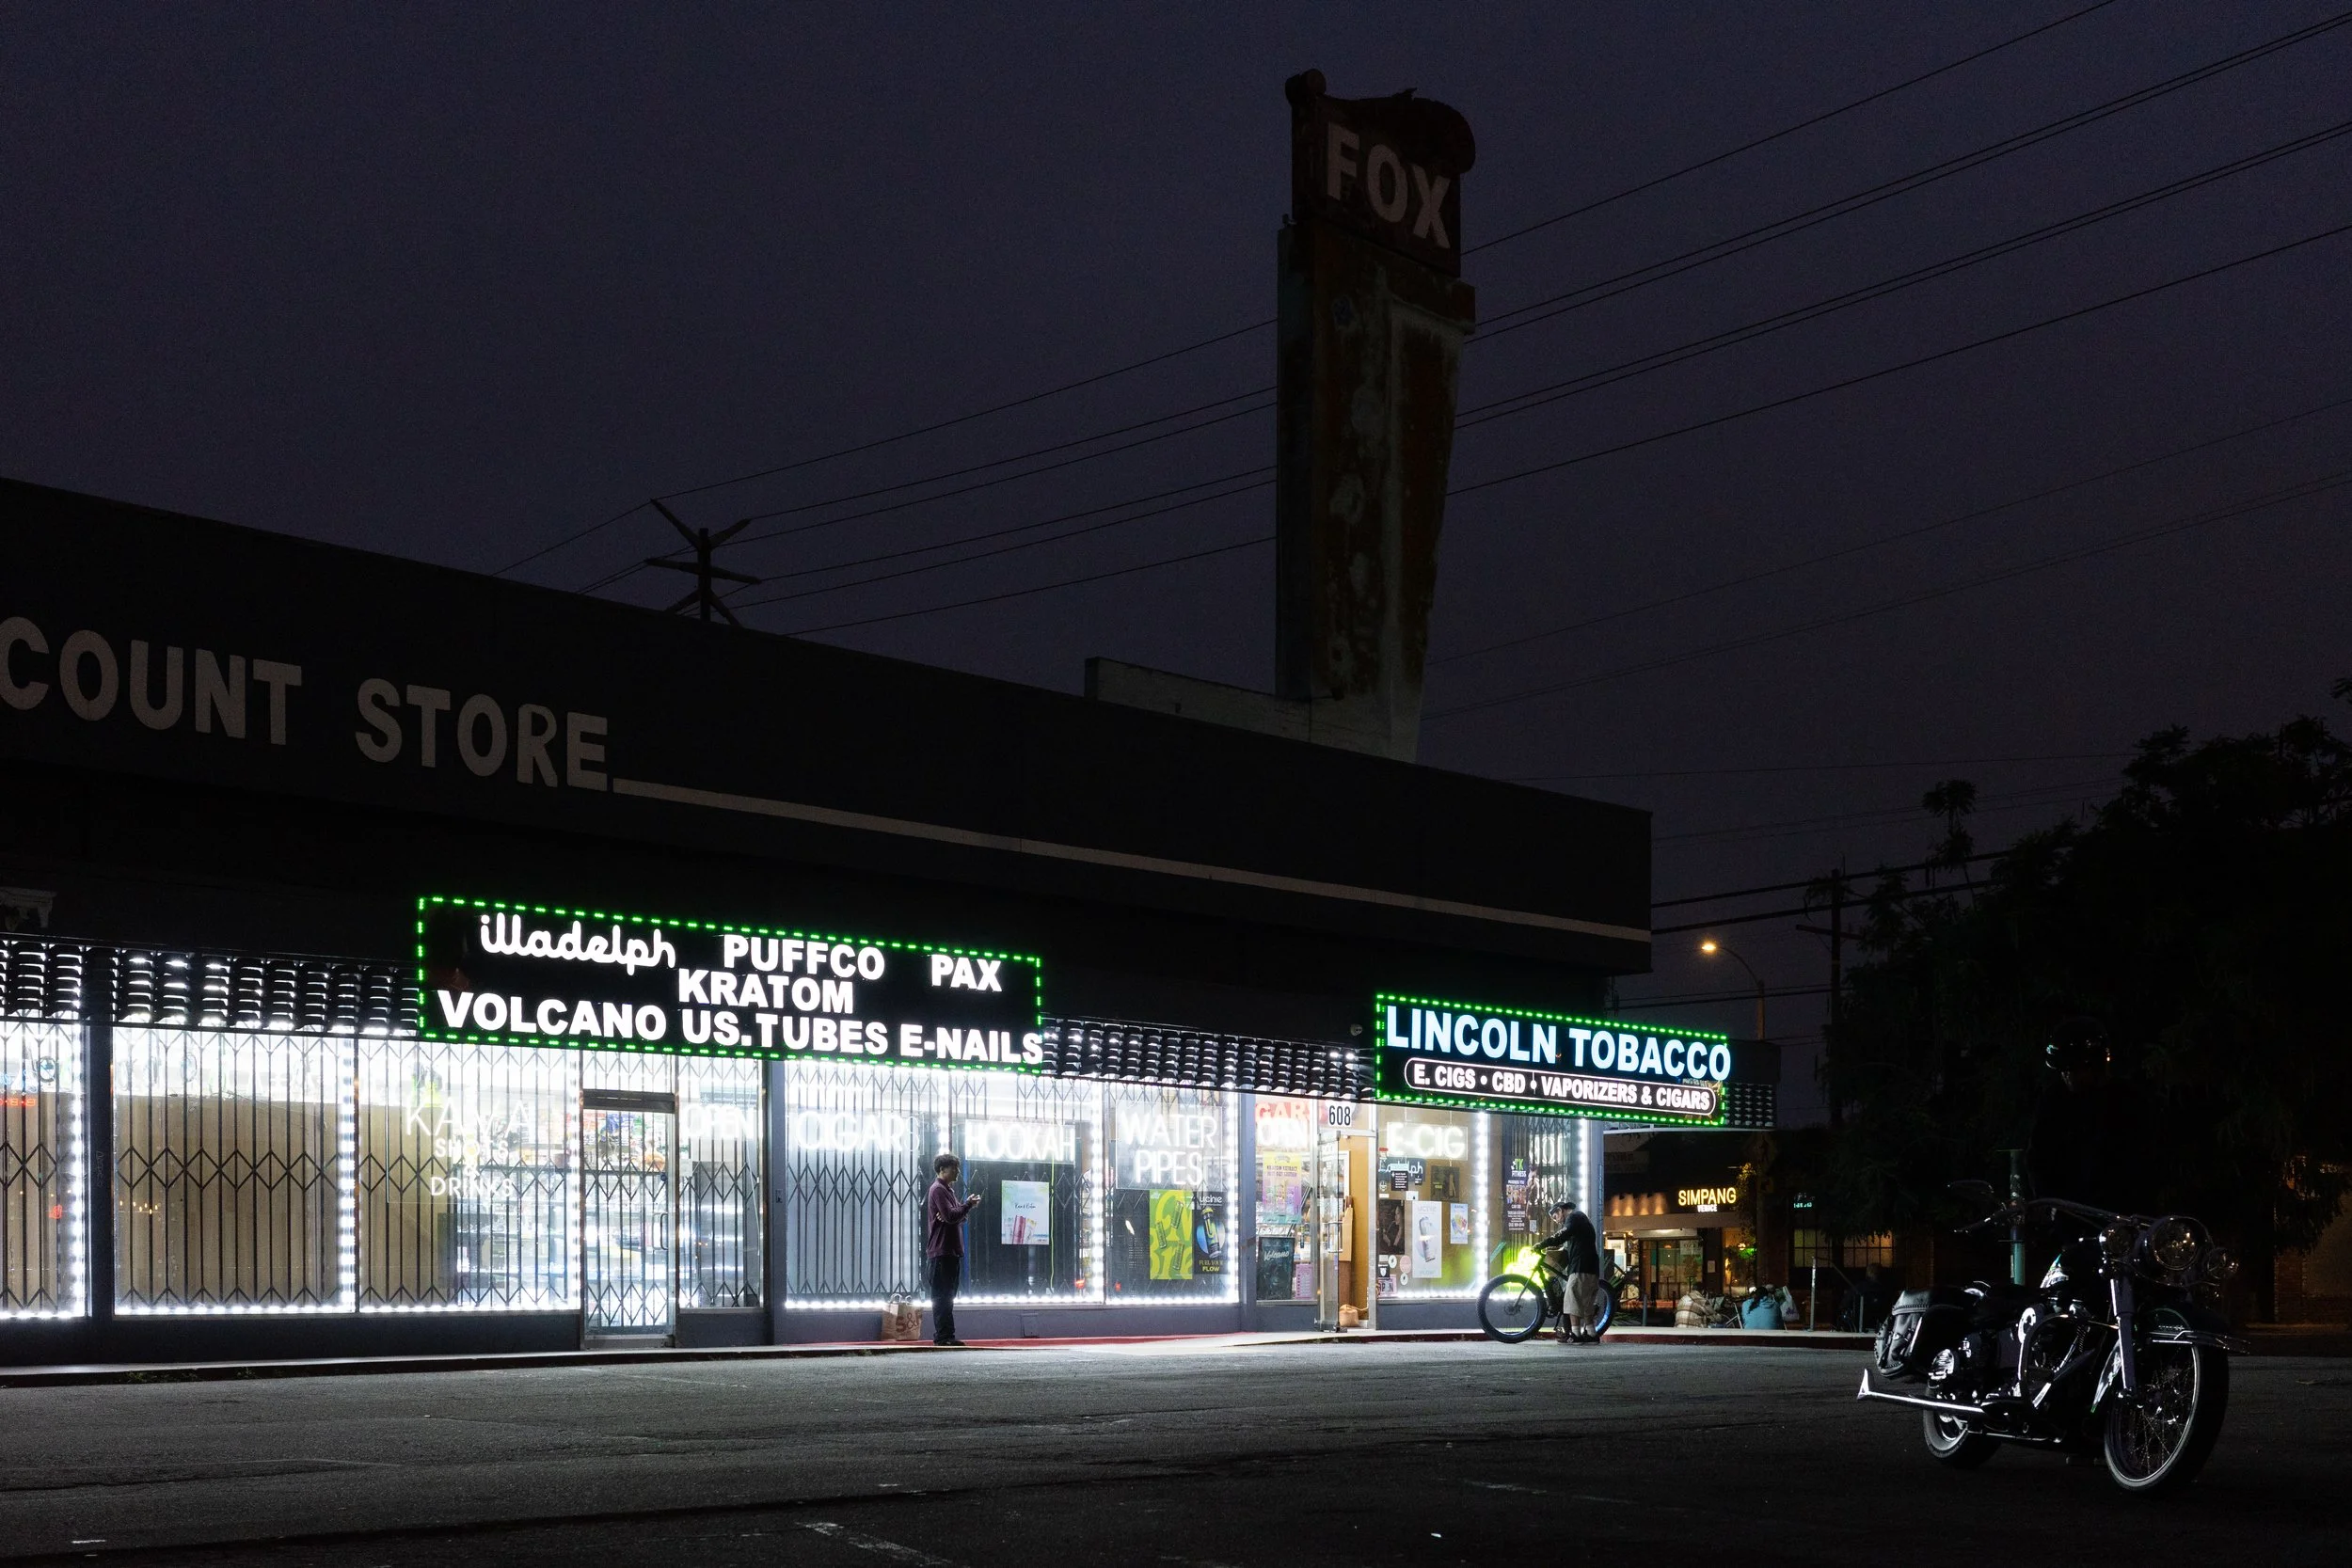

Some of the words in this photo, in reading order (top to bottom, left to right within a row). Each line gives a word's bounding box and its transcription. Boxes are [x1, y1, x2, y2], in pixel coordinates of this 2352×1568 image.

[1327, 121, 1451, 248] FOX
[0, 616, 302, 745] COUNT
[355, 677, 609, 792] STORE
[480, 912, 676, 975] illadelph
[723, 934, 885, 980] PUFFCO
[930, 954, 1002, 991] PAX
[678, 969, 853, 1014] KRATOM
[437, 990, 666, 1040] VOLCANO
[900, 1024, 1044, 1065] E-NAILS
[1387, 1005, 1557, 1064] LINCOLN
[1569, 1028, 1731, 1080] TOBACCO
[1435, 1066, 1476, 1090] CIGS
[1492, 1071, 1526, 1094] CBD
[1541, 1075, 1638, 1104] VAPORIZERS
[1641, 1088, 1653, 1105] &
[1656, 1088, 1710, 1111] CIGARS
[406, 1096, 532, 1138] KAVA
[1120, 1111, 1217, 1148] WATER
[1328, 1105, 1351, 1126] 608
[965, 1121, 1074, 1162] HOOKAH
[1387, 1121, 1466, 1159] E-CIG
[431, 1177, 514, 1197] DRINKS
[1135, 1149, 1203, 1185] PIPES
[1677, 1187, 1737, 1206] SIMPANG
